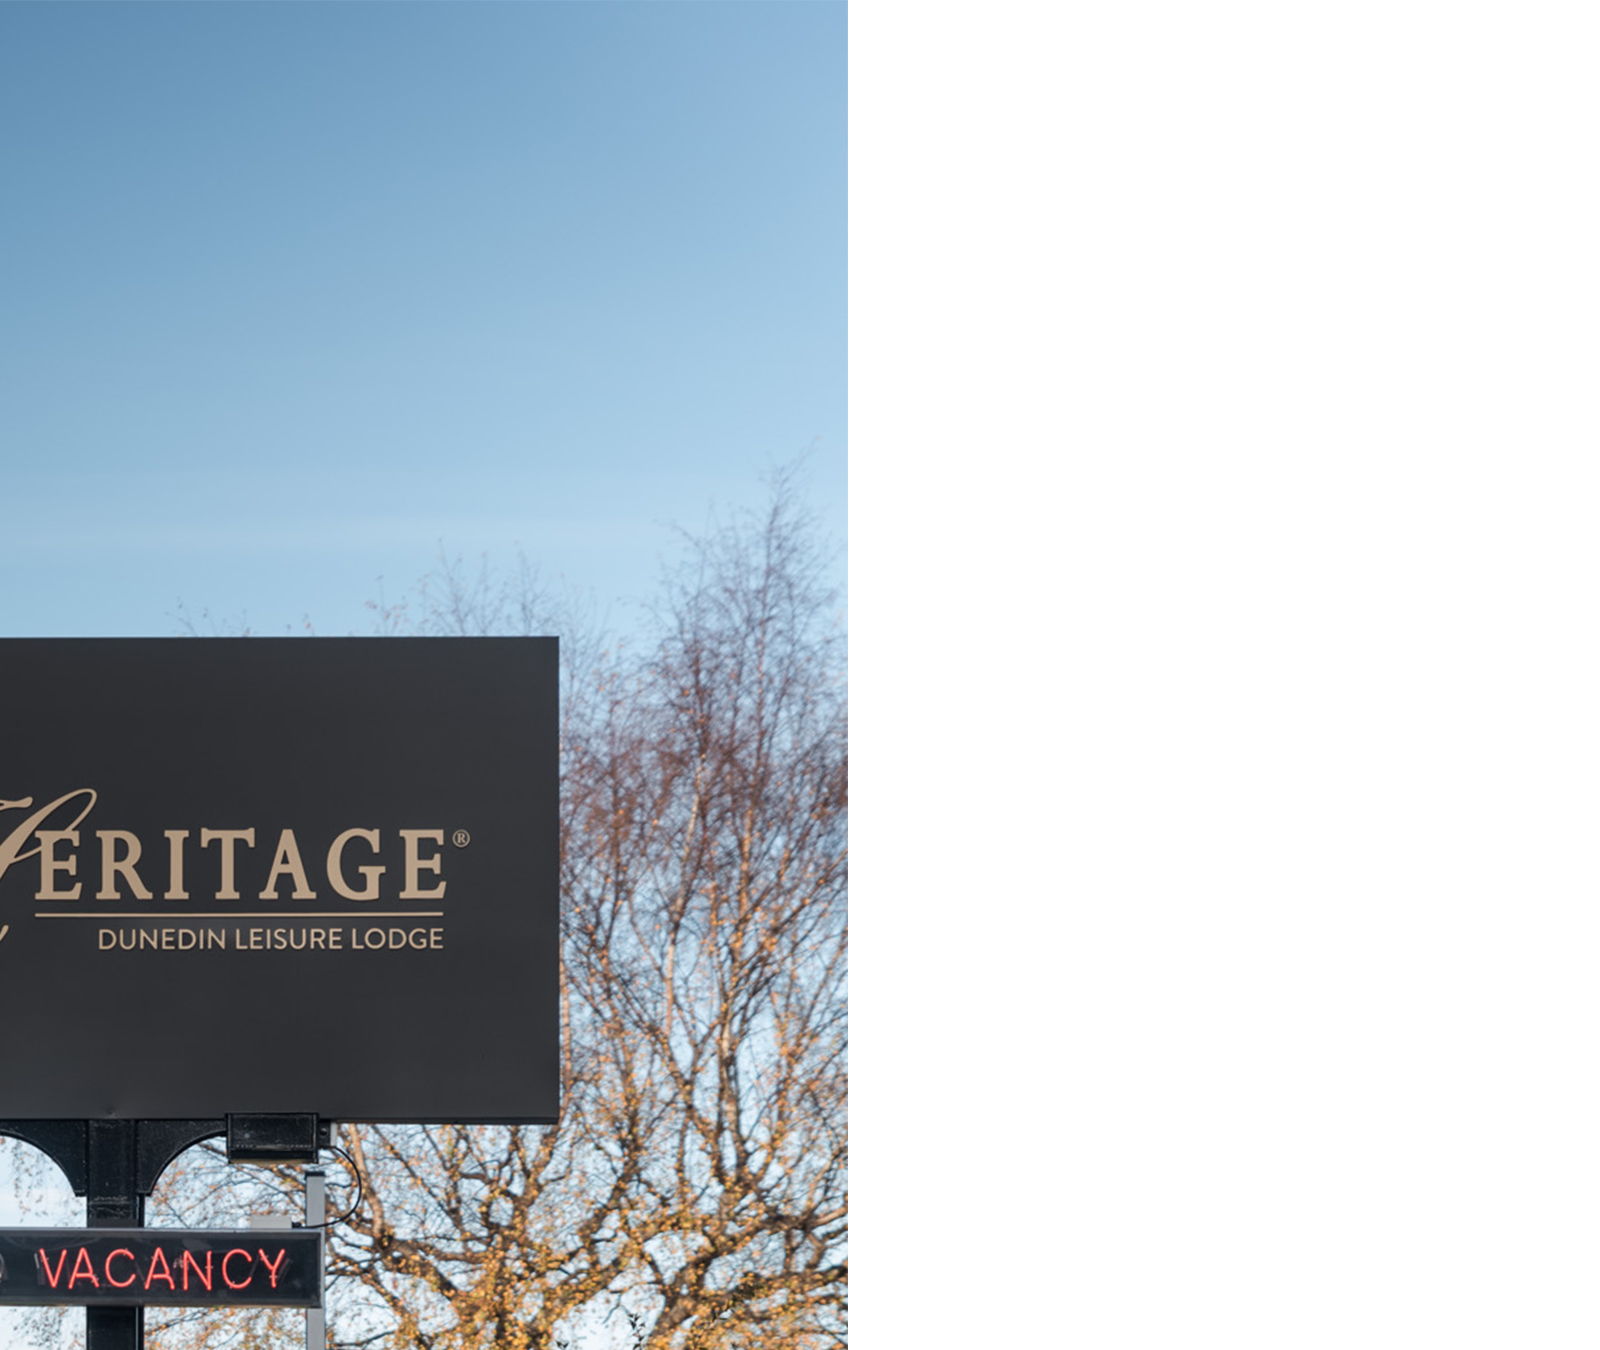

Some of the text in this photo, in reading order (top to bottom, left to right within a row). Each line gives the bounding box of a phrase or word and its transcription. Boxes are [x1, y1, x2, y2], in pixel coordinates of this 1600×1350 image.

[99, 927, 445, 951] DUNEDIN LEISURE LODGE
[37, 1246, 287, 1292] VACANCY
